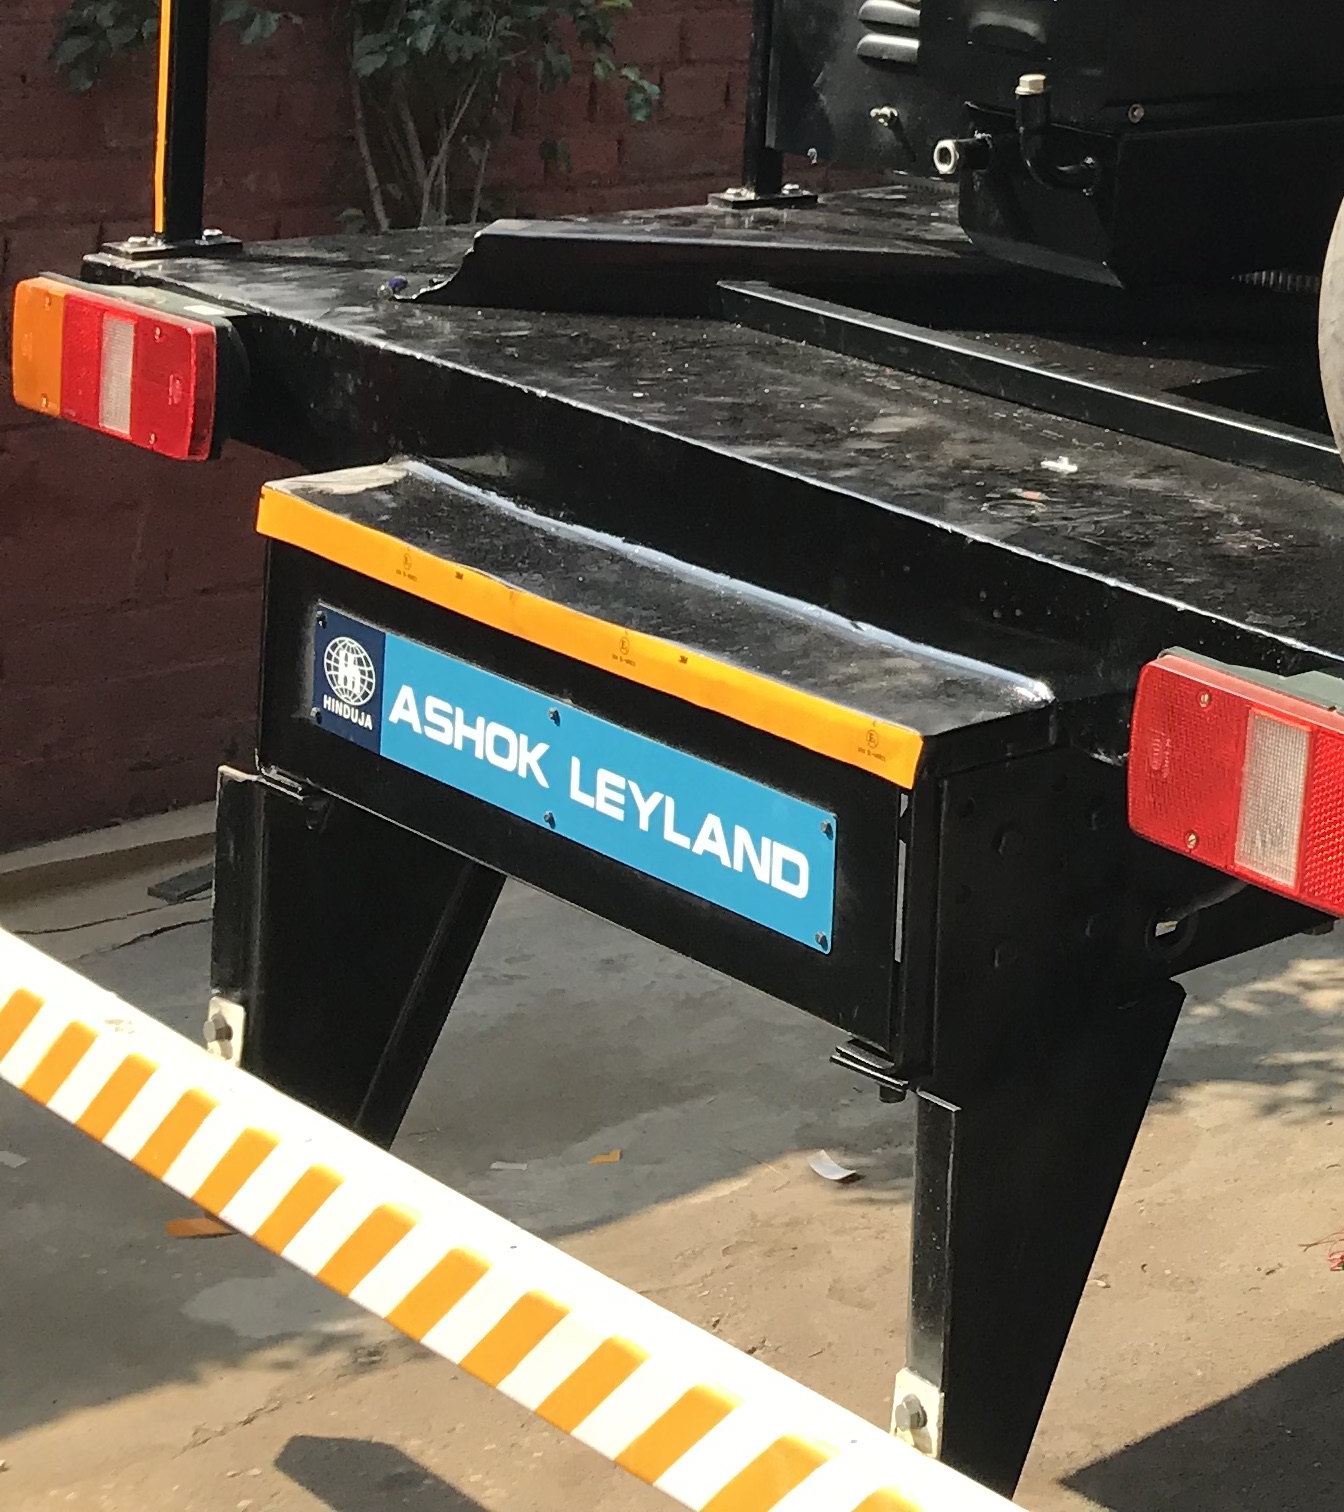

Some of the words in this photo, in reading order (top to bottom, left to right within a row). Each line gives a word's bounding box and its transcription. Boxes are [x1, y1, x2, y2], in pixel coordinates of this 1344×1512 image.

[323, 694, 373, 731] HINDUJA
[388, 684, 551, 788] ASHOK
[568, 755, 811, 900] LEYLAND
